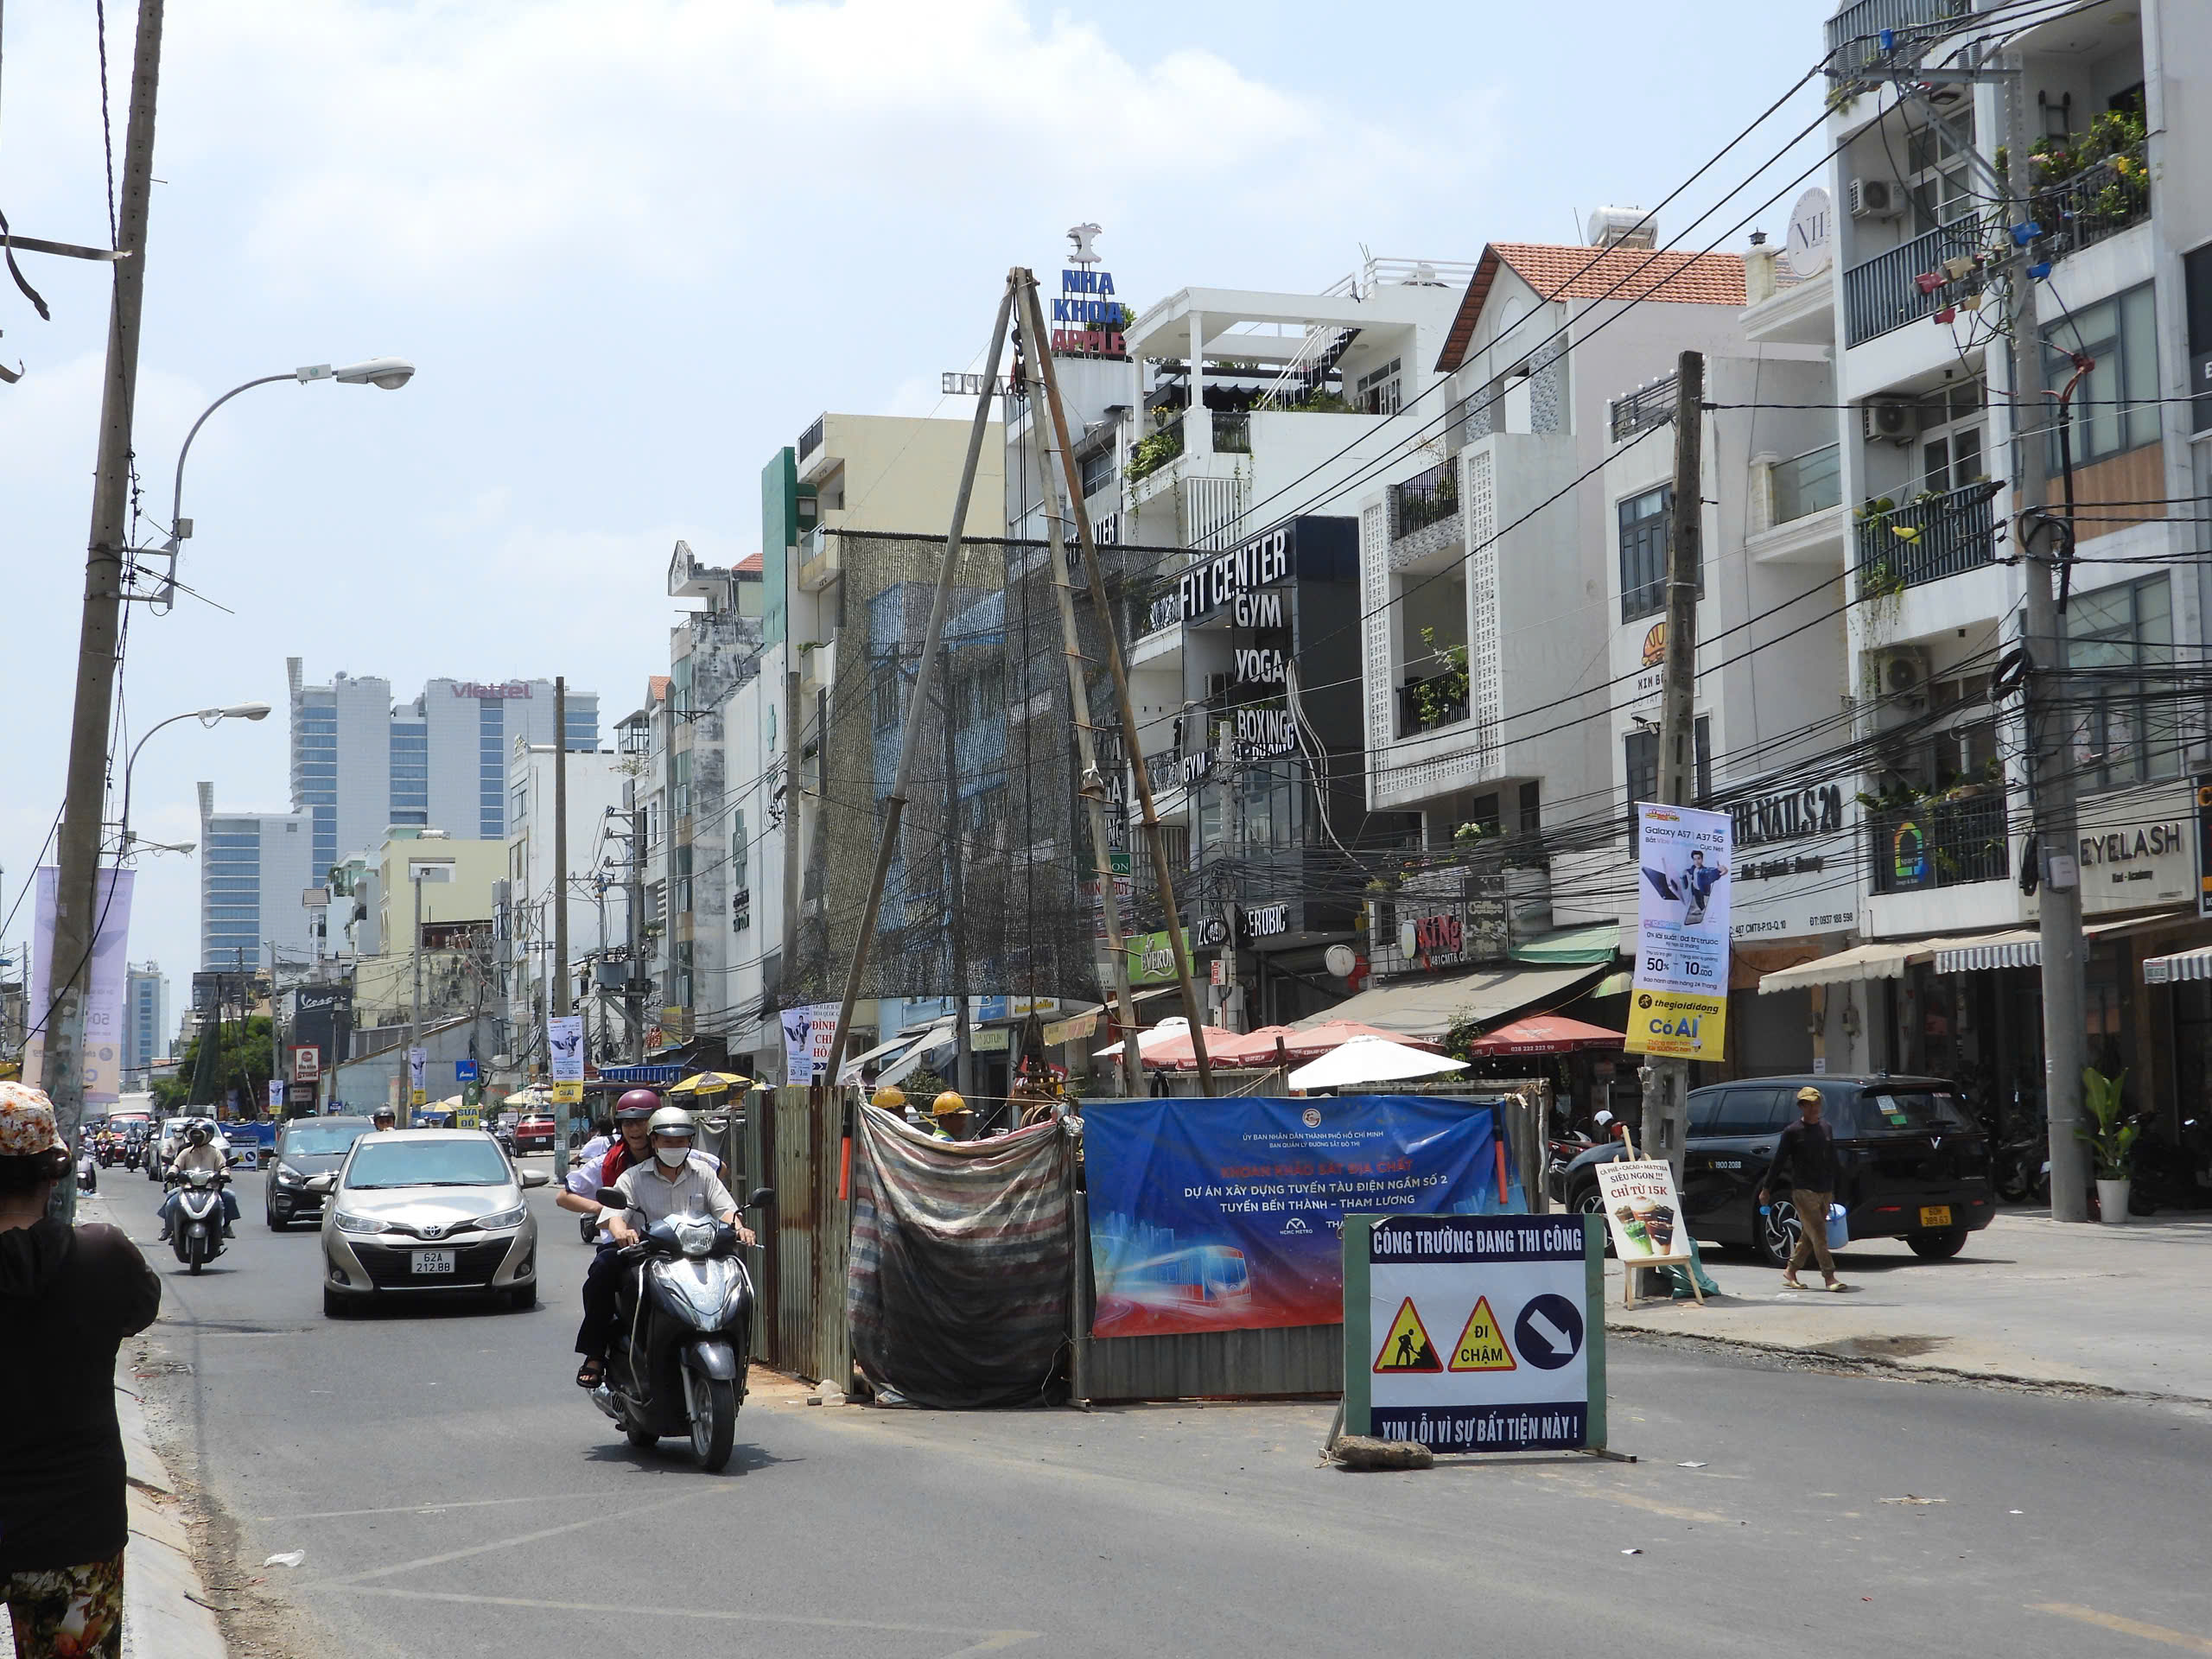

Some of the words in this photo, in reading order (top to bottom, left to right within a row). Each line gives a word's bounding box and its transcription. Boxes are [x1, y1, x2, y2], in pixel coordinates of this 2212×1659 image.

[1062, 270, 1115, 295] NHA
[1054, 299, 1123, 324] KHOA
[1051, 329, 1127, 354] APPLE
[1181, 565, 1207, 621] FIT
[1211, 529, 1287, 606] CENTER
[1235, 594, 1282, 628] GYM
[1236, 649, 1286, 683] YOGA
[451, 682, 532, 699] viettel
[1237, 709, 1287, 744] BOXING
[1184, 751, 1205, 782] GYM
[1645, 826, 1675, 837] Galaxy
[2080, 822, 2182, 867] EYELASH
[1843, 912, 1853, 922] 598
[1647, 957, 1669, 972] 50%
[1655, 999, 1719, 1014] thegioididong
[812, 1019, 836, 1030] ĐÌNH
[1649, 1018, 1673, 1035] Có
[1675, 1017, 1699, 1037] AI
[815, 1033, 832, 1044] CHÍ
[1268, 1131, 1288, 1140] NHÂN
[1289, 1130, 1304, 1140] DÂN
[1328, 1130, 1341, 1139] PHỐ
[1184, 1186, 1201, 1198] DỰ
[1205, 1185, 1222, 1197] ÁN
[1225, 1184, 1248, 1197] XÂY
[1250, 1184, 1285, 1197] DỰNG
[1287, 1180, 1326, 1194] TUYẾN
[1329, 1180, 1353, 1192] TÀU
[1357, 1179, 1384, 1192] ĐIỆN
[1387, 1177, 1421, 1190] NGẦM
[1423, 1173, 1438, 1186] SỐ
[1440, 1175, 1448, 1185] 2
[1610, 1173, 1629, 1183] SIÊU
[1611, 1183, 1630, 1198] CHỈ
[1630, 1183, 1646, 1195] TỪ
[1649, 1186, 1669, 1196] 15K
[1220, 1199, 1259, 1212] TUYẾN
[1262, 1198, 1285, 1211] BẾN
[1287, 1197, 1327, 1211] THÀNH
[1339, 1198, 1373, 1208] THAM
[1376, 1194, 1415, 1206] LƯƠNG
[1373, 1227, 1413, 1254] CÔNG
[1415, 1225, 1473, 1254] TRƯỜNG
[1476, 1230, 1515, 1253] ĐANG
[1517, 1230, 1540, 1252] THI
[1543, 1224, 1582, 1252] CÔNG
[424, 1253, 442, 1262] 62A
[416, 1262, 450, 1272] 212.88
[1474, 1325, 1488, 1338] ĐI
[1460, 1345, 1503, 1364] CHẬM
[1382, 1420, 1408, 1442] XIN
[1411, 1413, 1433, 1443] LỖI
[1437, 1416, 1451, 1443] VÌ
[1455, 1419, 1476, 1447] SỰ
[1477, 1411, 1505, 1442] BẤT
[1507, 1413, 1538, 1445] TIỆN
[1541, 1413, 1570, 1440] NÀY
